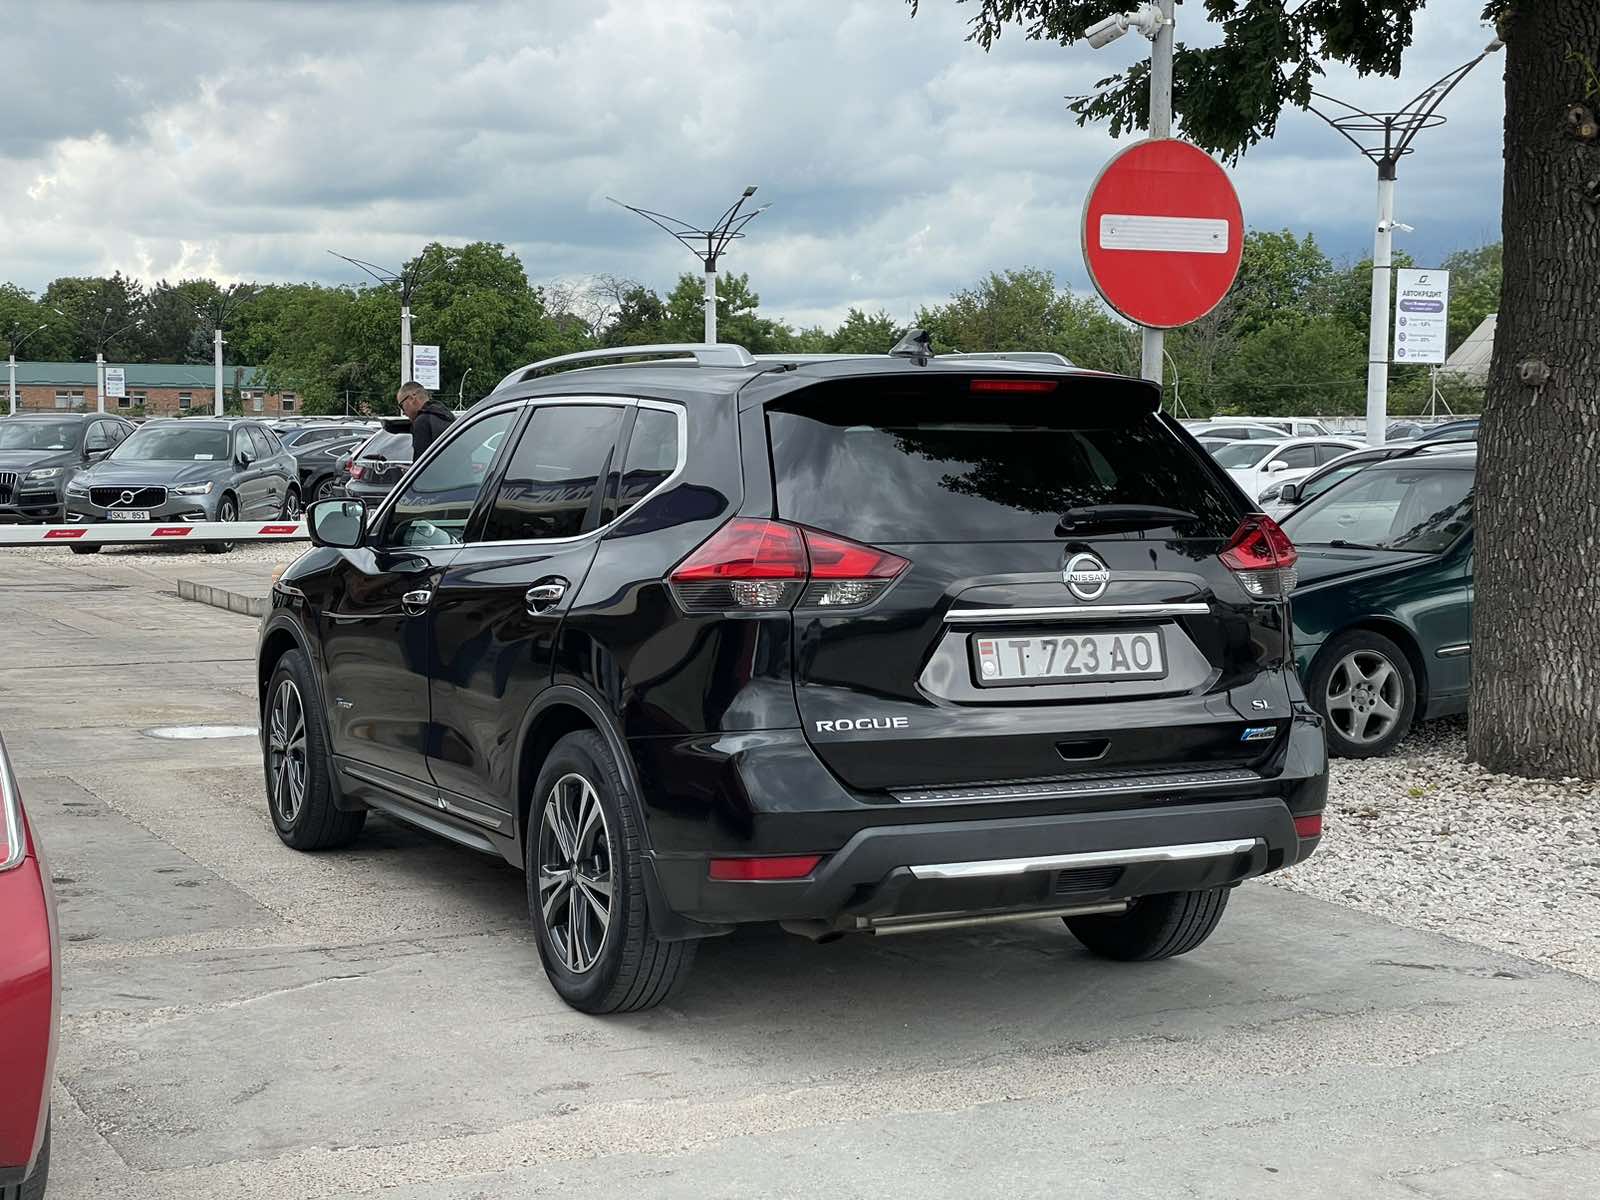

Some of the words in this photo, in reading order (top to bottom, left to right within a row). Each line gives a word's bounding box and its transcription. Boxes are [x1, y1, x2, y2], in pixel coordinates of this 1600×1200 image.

[1402, 290, 1442, 298] АВТОКРЕДИТ
[112, 511, 127, 519] SKL
[131, 511, 145, 519] 851
[1069, 573, 1107, 582] NISSAN
[1008, 640, 1031, 676] T
[1040, 637, 1100, 675] 723
[1110, 635, 1153, 672] AO
[1251, 699, 1272, 711] SL
[815, 716, 910, 733] ROGUE
